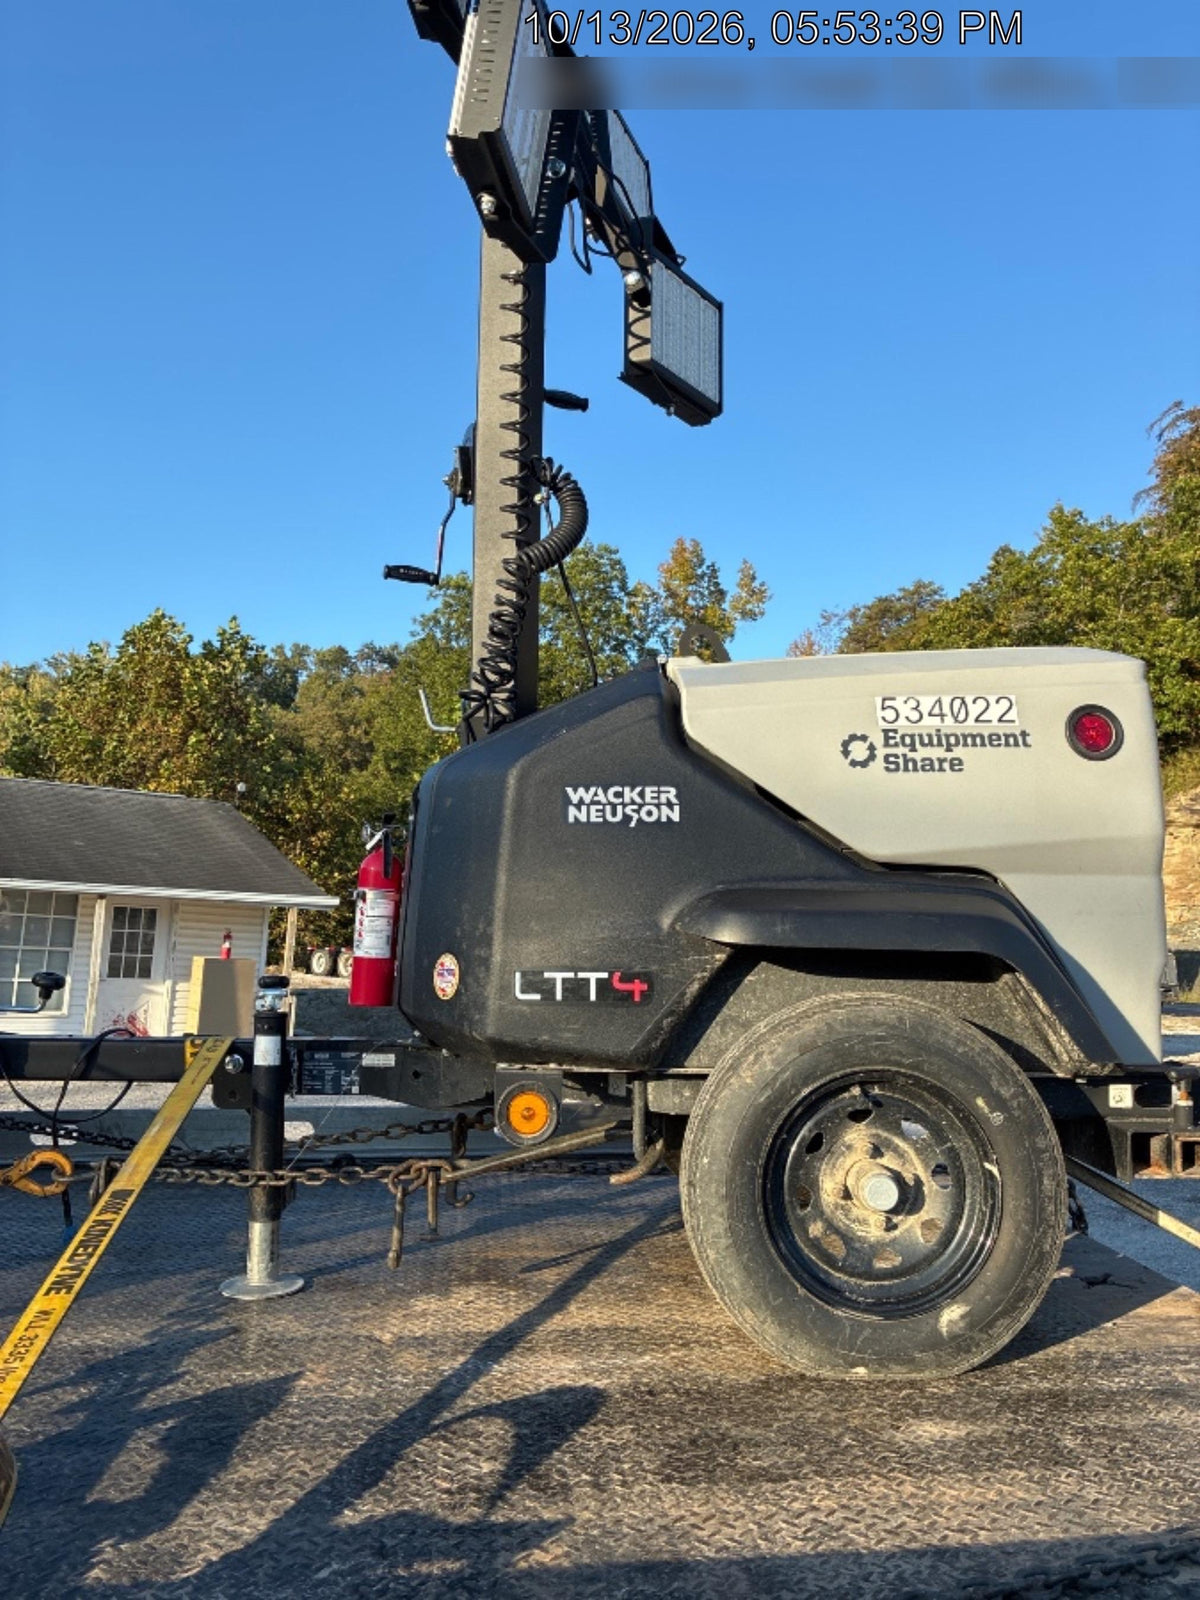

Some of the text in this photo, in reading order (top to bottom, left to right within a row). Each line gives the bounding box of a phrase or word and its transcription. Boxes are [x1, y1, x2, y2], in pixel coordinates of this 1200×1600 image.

[880, 695, 1017, 725] 534022
[881, 728, 1032, 753] Equipment
[883, 753, 965, 773] Share
[565, 786, 680, 805] WACKER
[568, 804, 681, 828] NEUSON
[515, 971, 649, 1003] LTT4
[42, 1218, 118, 1297] KINEDYNE
